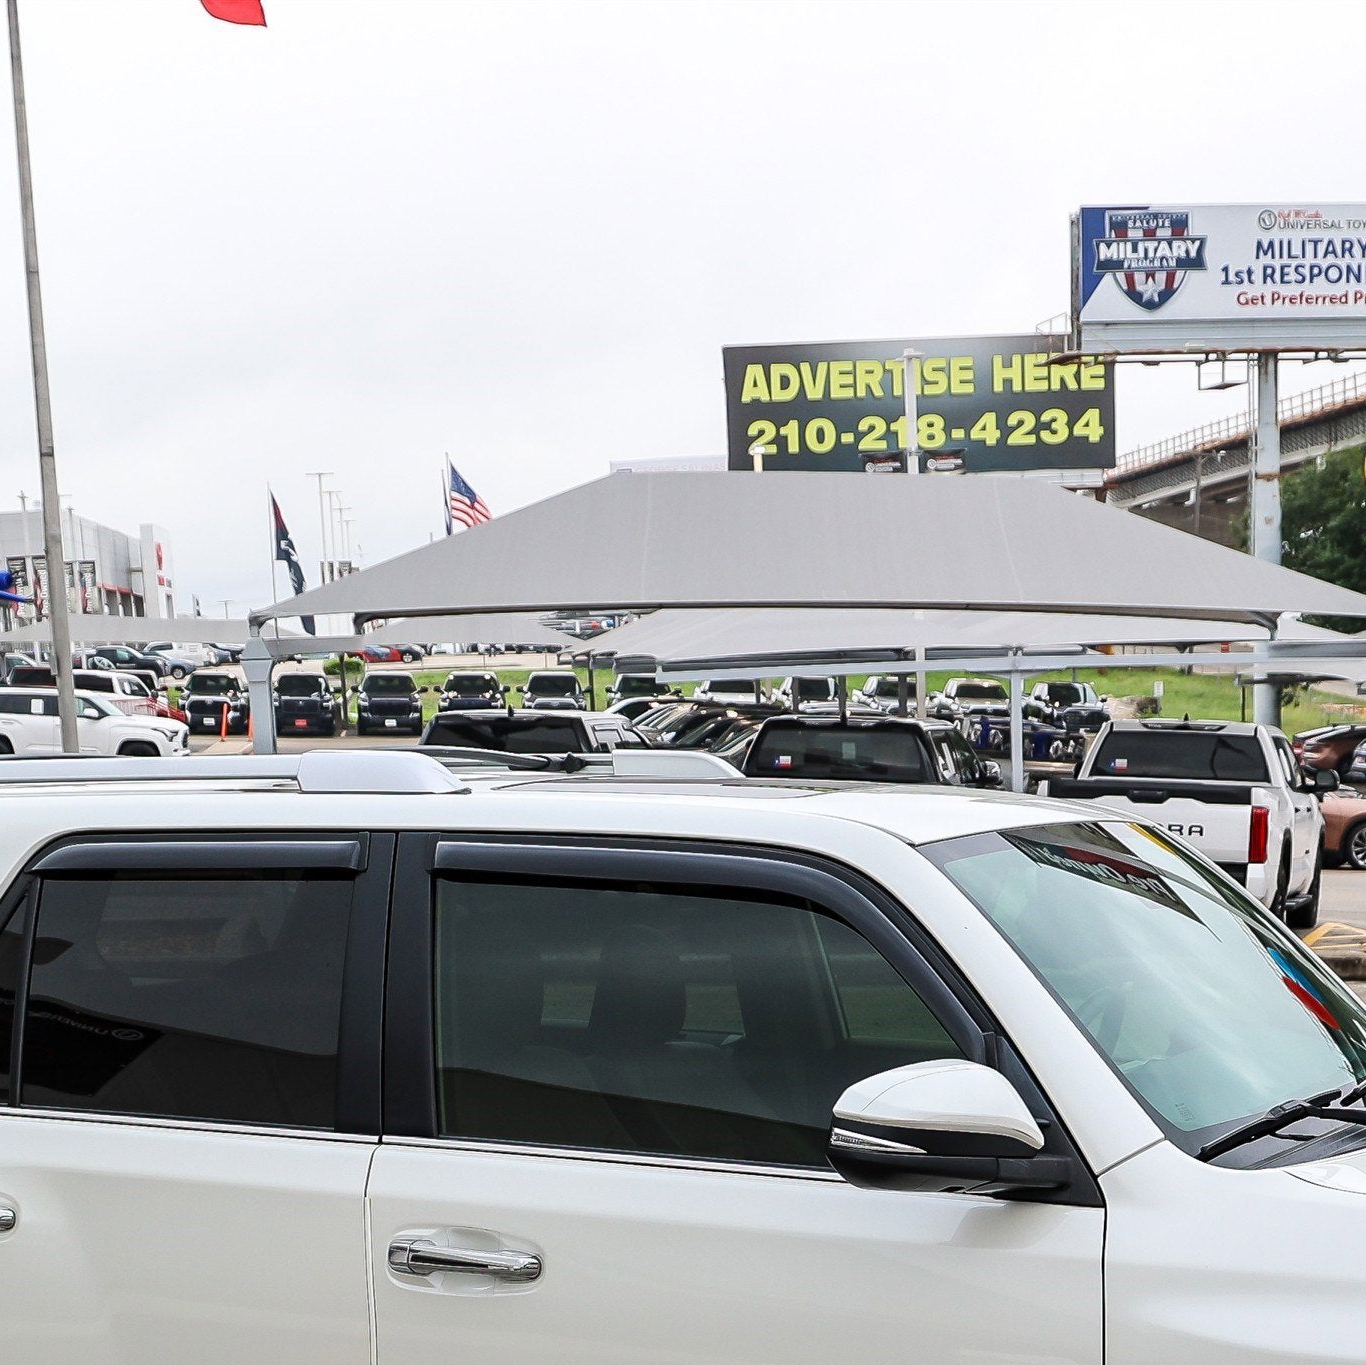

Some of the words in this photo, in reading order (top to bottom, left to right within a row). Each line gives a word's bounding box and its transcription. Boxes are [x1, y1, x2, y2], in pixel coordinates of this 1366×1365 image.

[1128, 219, 1172, 228] SALUTE
[1278, 219, 1344, 230] UNIVERSAL
[1098, 240, 1201, 262] MILITARY
[1123, 256, 1177, 269] PROGRAM
[1220, 263, 1256, 285] 1st
[1236, 290, 1266, 307] Get
[1271, 289, 1349, 306] Preferred
